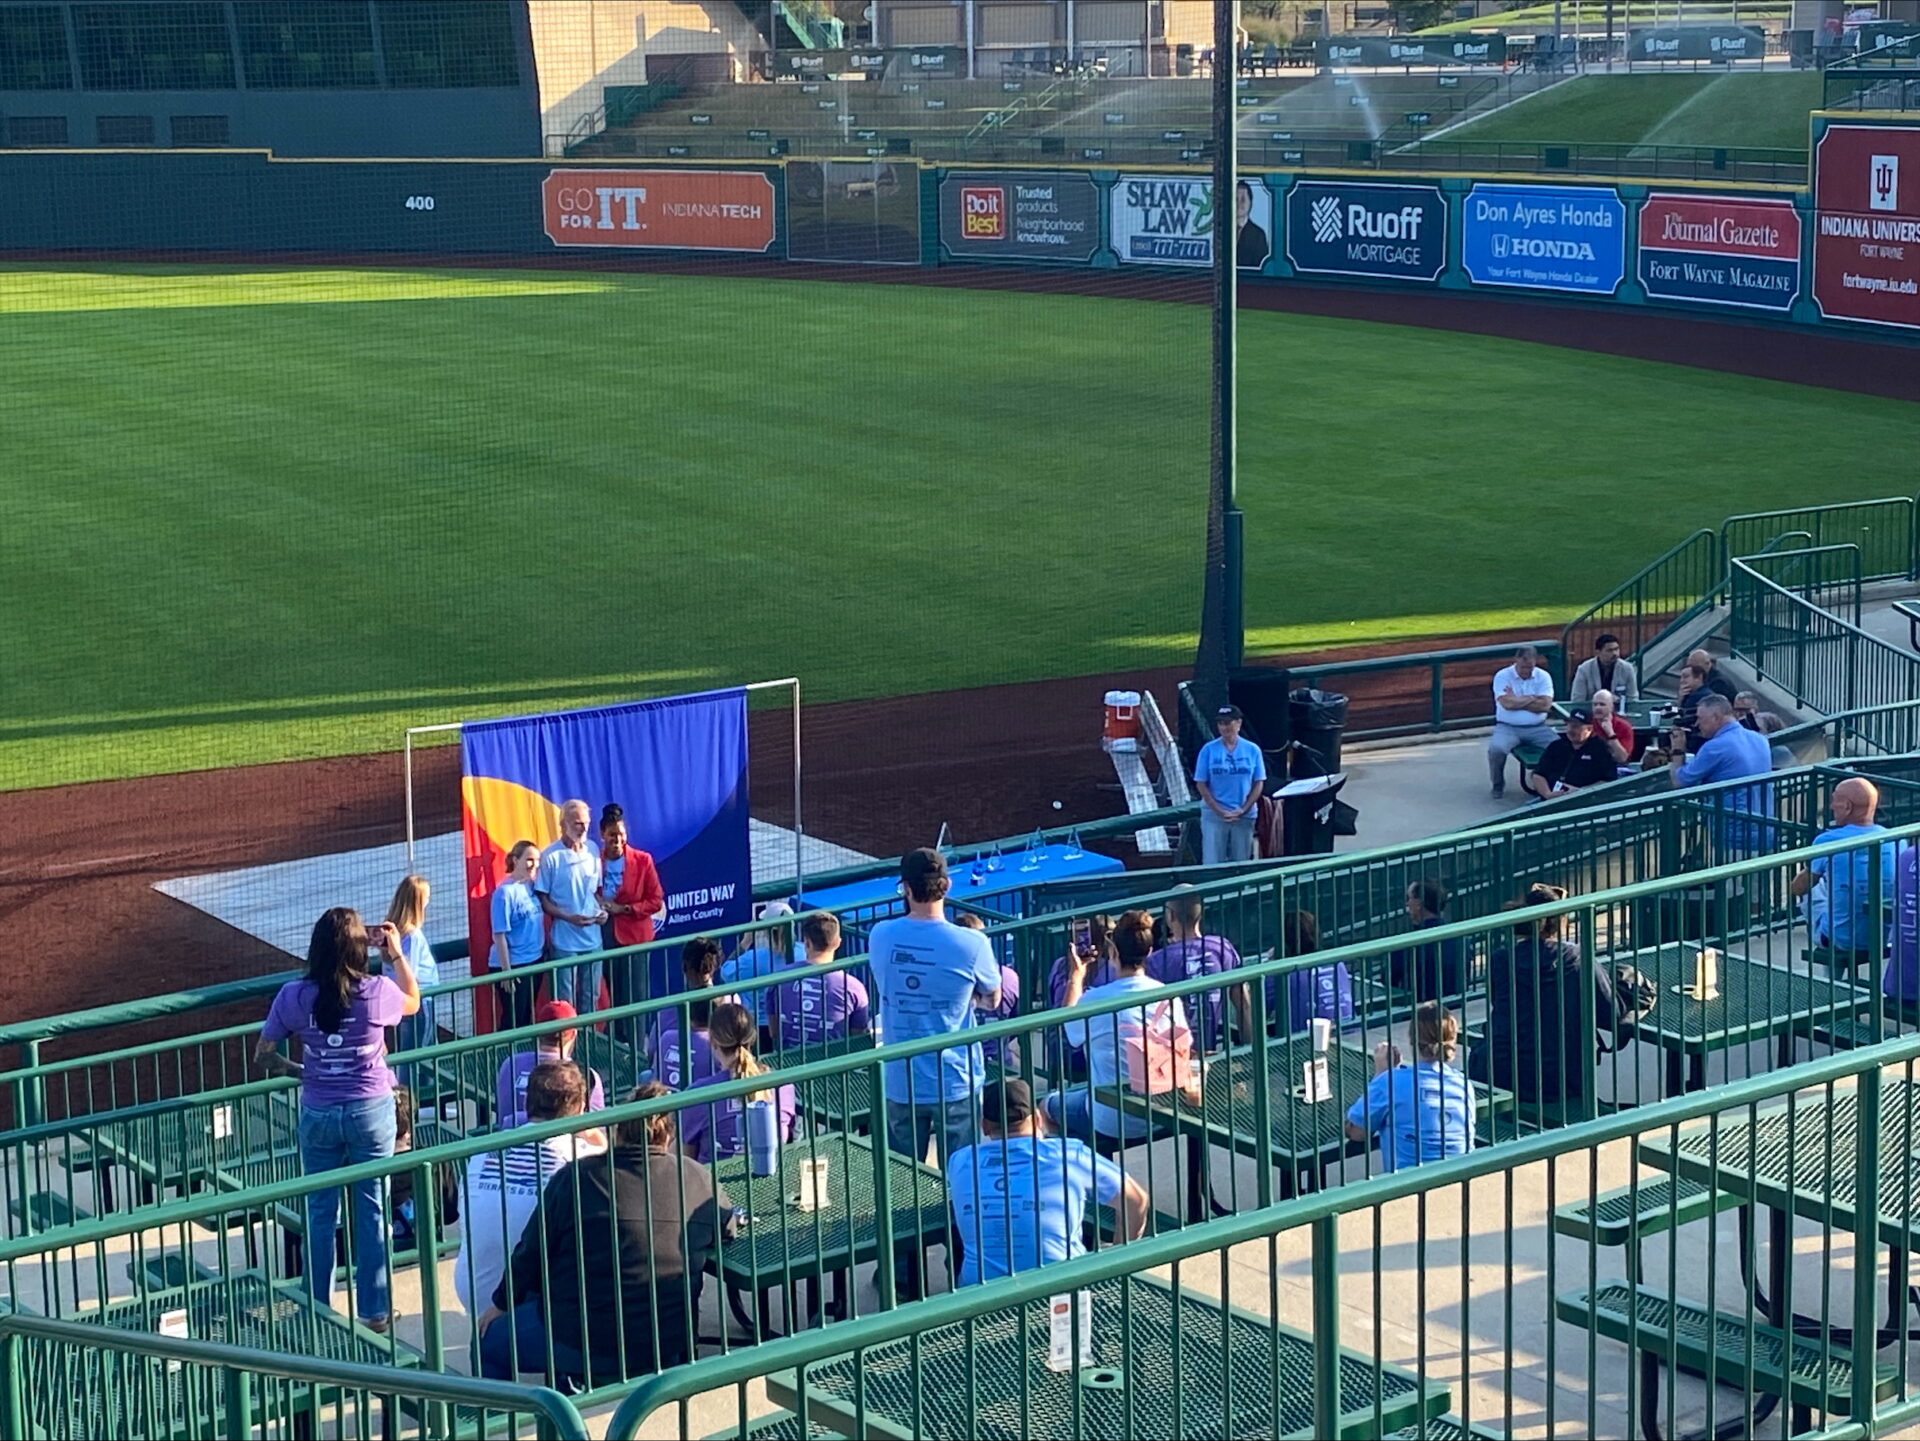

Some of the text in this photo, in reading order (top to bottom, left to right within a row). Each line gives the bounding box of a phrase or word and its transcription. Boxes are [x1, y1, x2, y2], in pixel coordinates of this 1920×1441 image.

[1339, 46, 1362, 57] Ruoff
[1400, 45, 1424, 56] Ruoff
[1464, 43, 1489, 54] Ruoff
[557, 187, 593, 212] GO
[1015, 186, 1052, 199] Trusted
[1126, 181, 1192, 209] SHAW
[405, 195, 435, 211] 400
[1016, 201, 1058, 214] products
[560, 214, 592, 228] FOR
[967, 214, 1000, 233] Best
[1141, 208, 1191, 235] LAW
[1348, 204, 1423, 240] Ruoff
[1476, 200, 1612, 229] Don Ayres Honda
[1017, 217, 1085, 232] Neighborhood
[1662, 214, 1779, 248] Journal Gazette
[1821, 215, 1869, 239] INDIANA
[1153, 238, 1207, 257] 777-7777
[1347, 243, 1421, 265] MORTGAGE
[1511, 238, 1596, 261] HONDA
[1859, 244, 1904, 260] FORT WAYNE
[1487, 266, 1504, 277] Your
[1505, 267, 1521, 278] Fort
[1523, 268, 1547, 282] Wayne
[1549, 270, 1573, 282] Honda
[1650, 260, 1791, 292] FORT WAYNE MAGAZINE
[1842, 271, 1918, 294] fortwayne.iu.edu
[667, 883, 736, 910] UNITED WAY
[668, 907, 724, 925] Allen County
